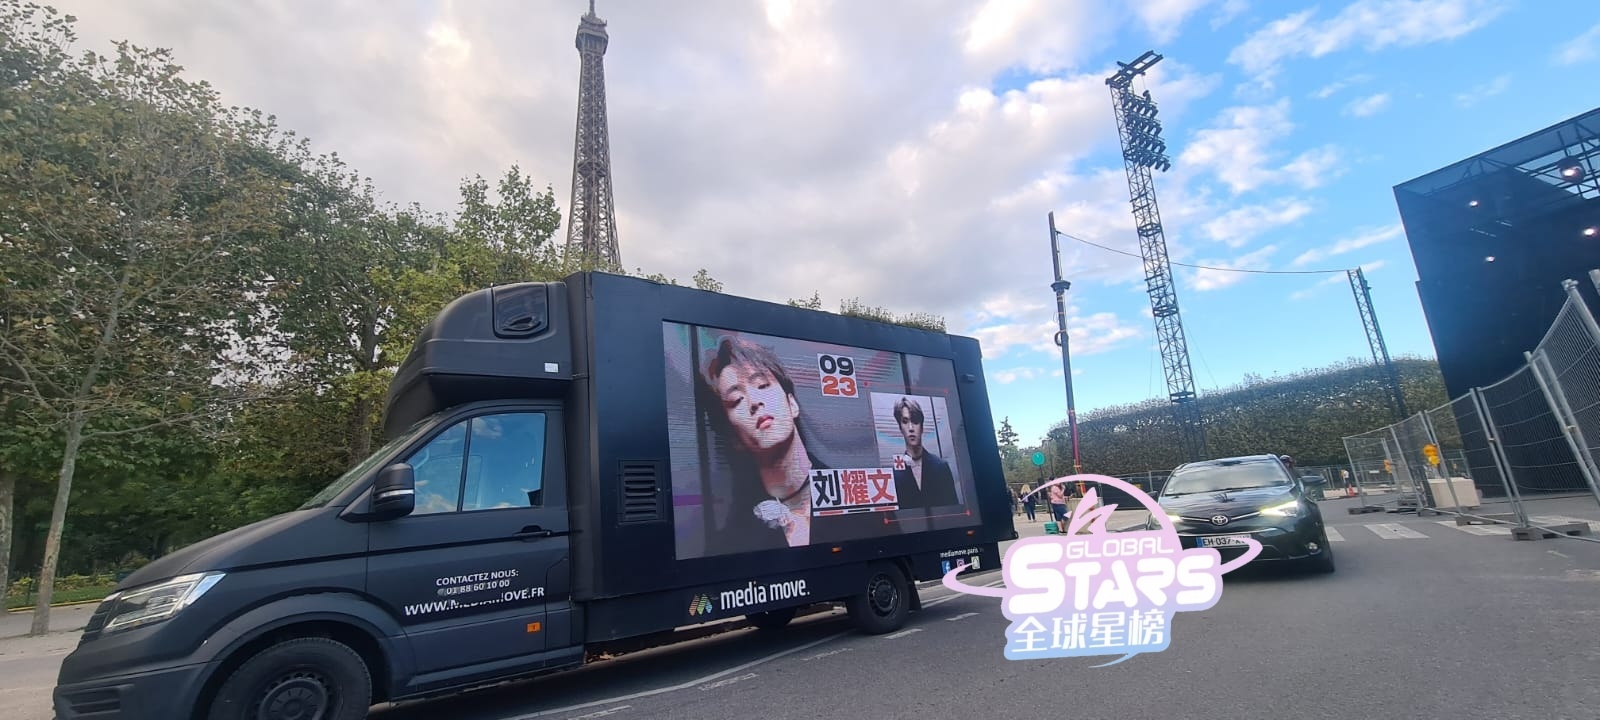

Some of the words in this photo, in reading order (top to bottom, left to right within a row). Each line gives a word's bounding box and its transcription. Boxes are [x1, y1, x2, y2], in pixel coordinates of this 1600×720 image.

[820, 355, 854, 376] 09
[822, 375, 857, 397] 23
[812, 469, 895, 507] 刘耀文
[436, 572, 489, 586] CONTACTEZ
[491, 569, 519, 579] NOUS:
[486, 581, 497, 589] 10
[499, 579, 510, 588] 00
[720, 580, 767, 610] media
[770, 579, 810, 601] move.
